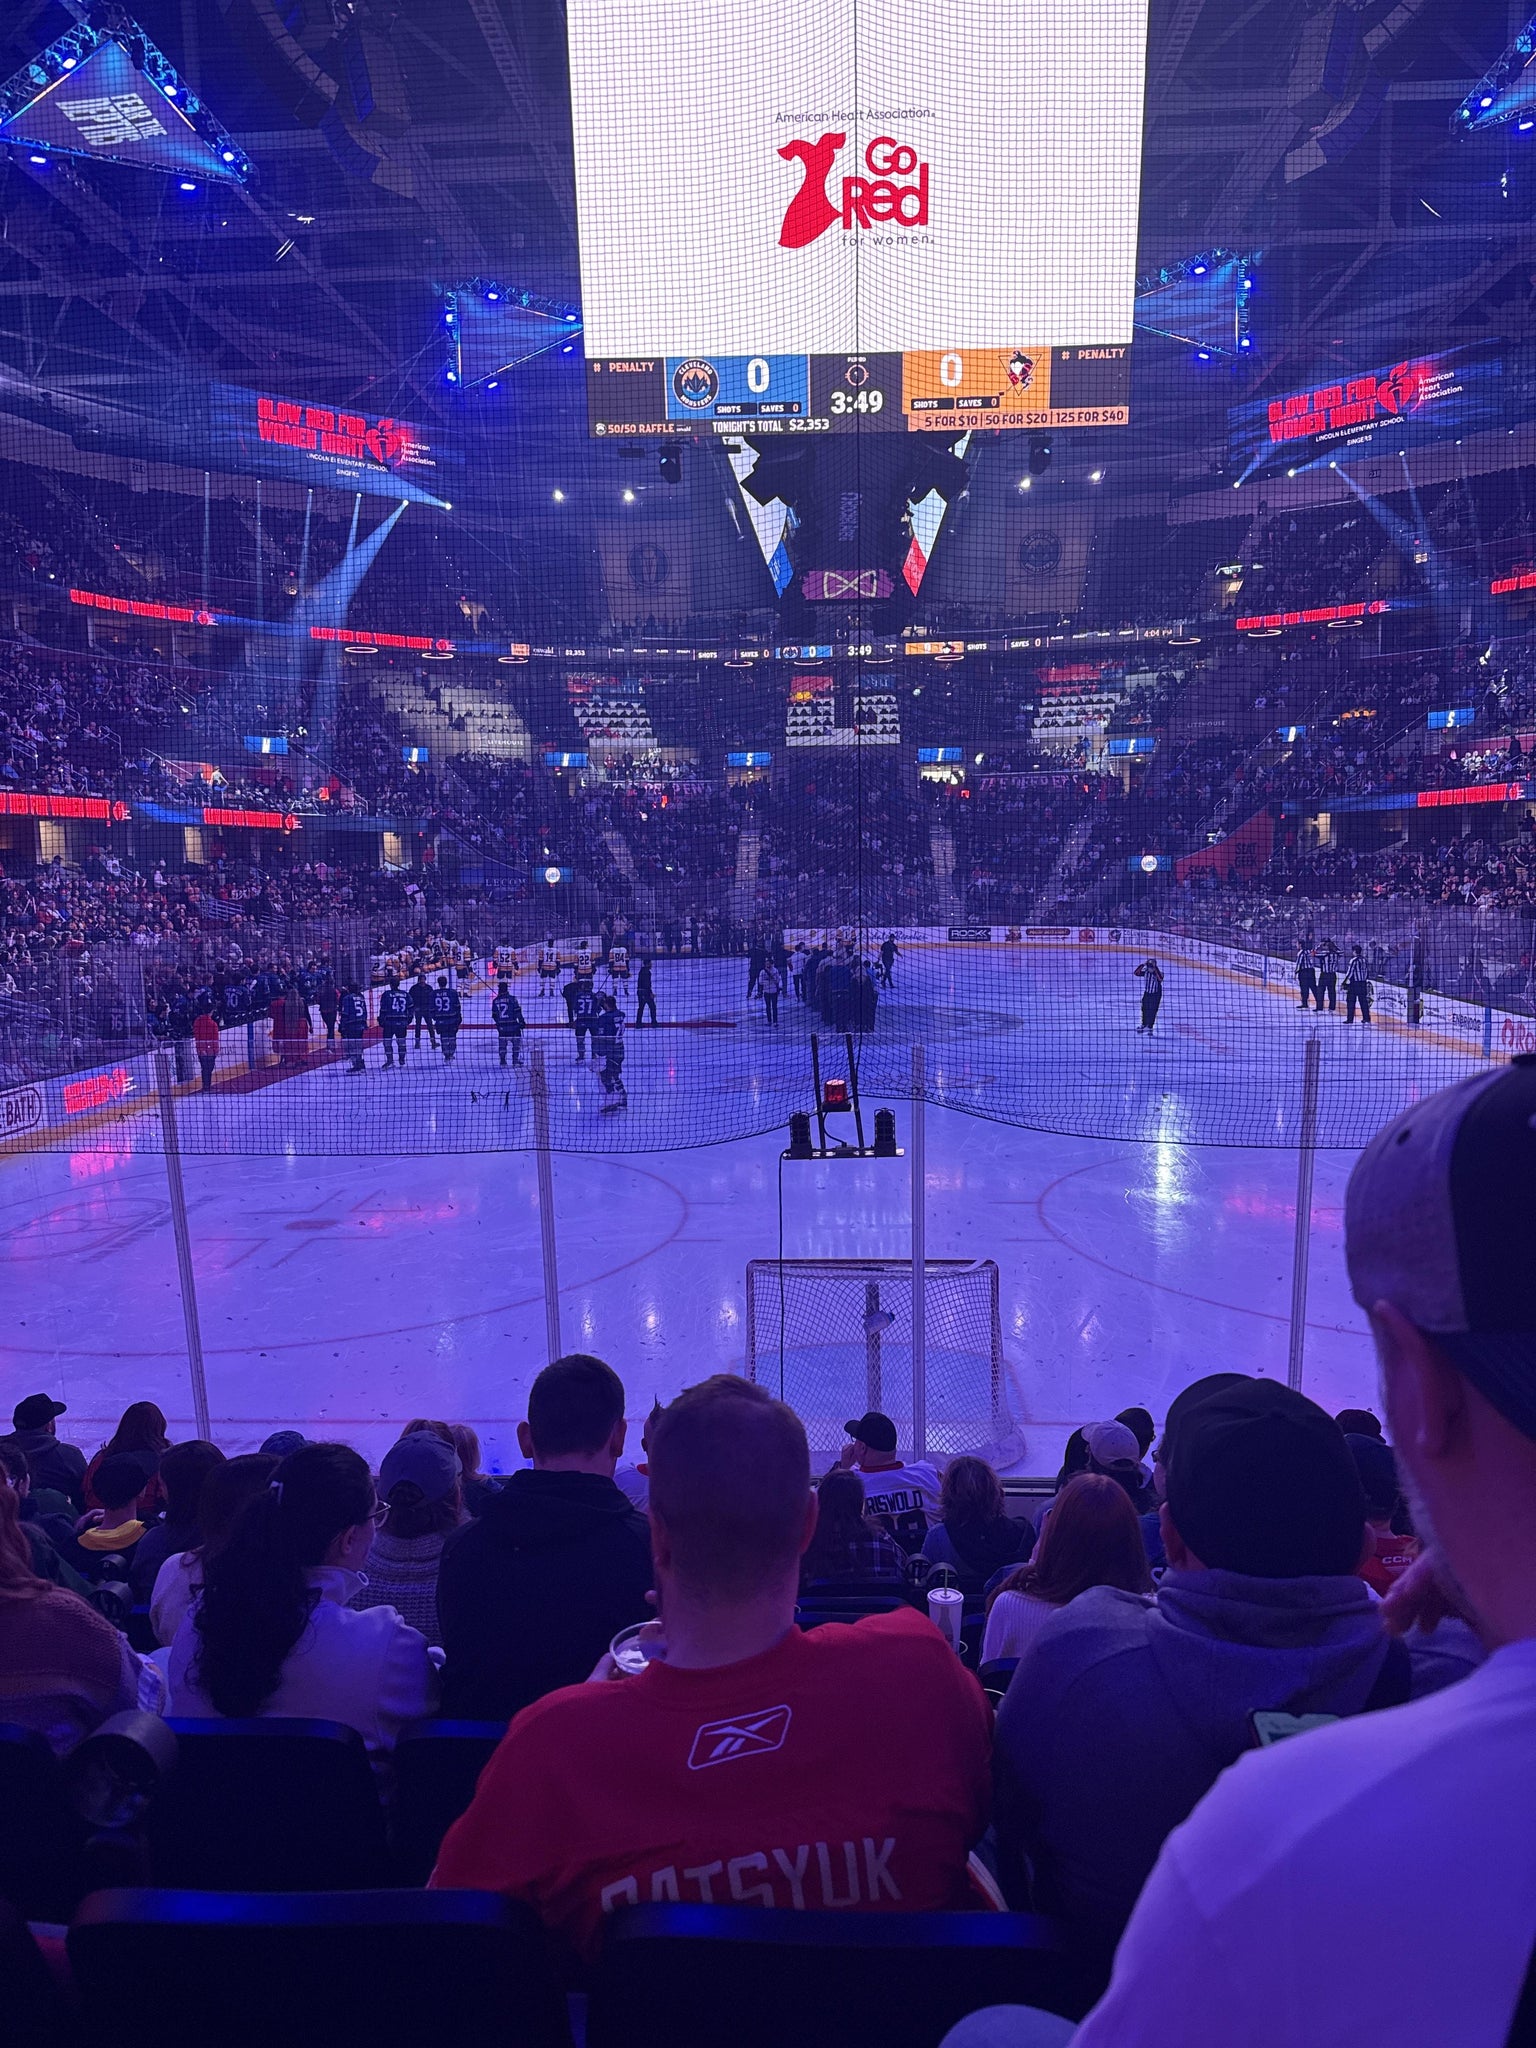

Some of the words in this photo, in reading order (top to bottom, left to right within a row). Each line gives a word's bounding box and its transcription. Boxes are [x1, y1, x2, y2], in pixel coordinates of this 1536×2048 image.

[775, 112, 829, 123] American
[865, 136, 917, 176] Go
[842, 162, 929, 230] Red
[842, 235, 864, 246] for
[1078, 348, 1125, 360] PENALTY
[609, 362, 654, 372] PENALTY
[940, 353, 962, 387] 0
[747, 358, 770, 393] 0
[1346, 377, 1376, 403] FOR
[761, 403, 784, 413] SAVES
[830, 391, 884, 414] 3:49
[913, 400, 938, 409] SHOTS
[958, 399, 982, 408] SAVES
[717, 404, 742, 414] SHOTS
[258, 398, 302, 425] GLOW
[306, 407, 334, 431] RED
[339, 414, 366, 437] FOR
[935, 416, 956, 427] FOR
[958, 415, 978, 427] $10
[985, 415, 999, 425] 50
[1002, 414, 1023, 424] FOR
[1026, 413, 1048, 425] $20
[1056, 412, 1074, 423] 125
[1078, 411, 1099, 422] FOR
[1102, 410, 1124, 422] $40
[1269, 411, 1326, 443] WOMEN
[1330, 398, 1377, 429] NIGHT
[608, 424, 637, 434] 50/50
[639, 423, 675, 433] RAFFLE
[713, 421, 755, 433] TONIGHT'S
[758, 420, 783, 431] TOTAL
[789, 418, 829, 431] $2,353
[258, 419, 317, 450] WOMEN
[322, 431, 366, 459] NIGHT
[809, 645, 816, 657] 0
[847, 645, 872, 656] 3:49
[967, 643, 987, 651] SHOTS
[698, 651, 718, 659] SHOTS
[866, 1490, 923, 1515] RISWOLD
